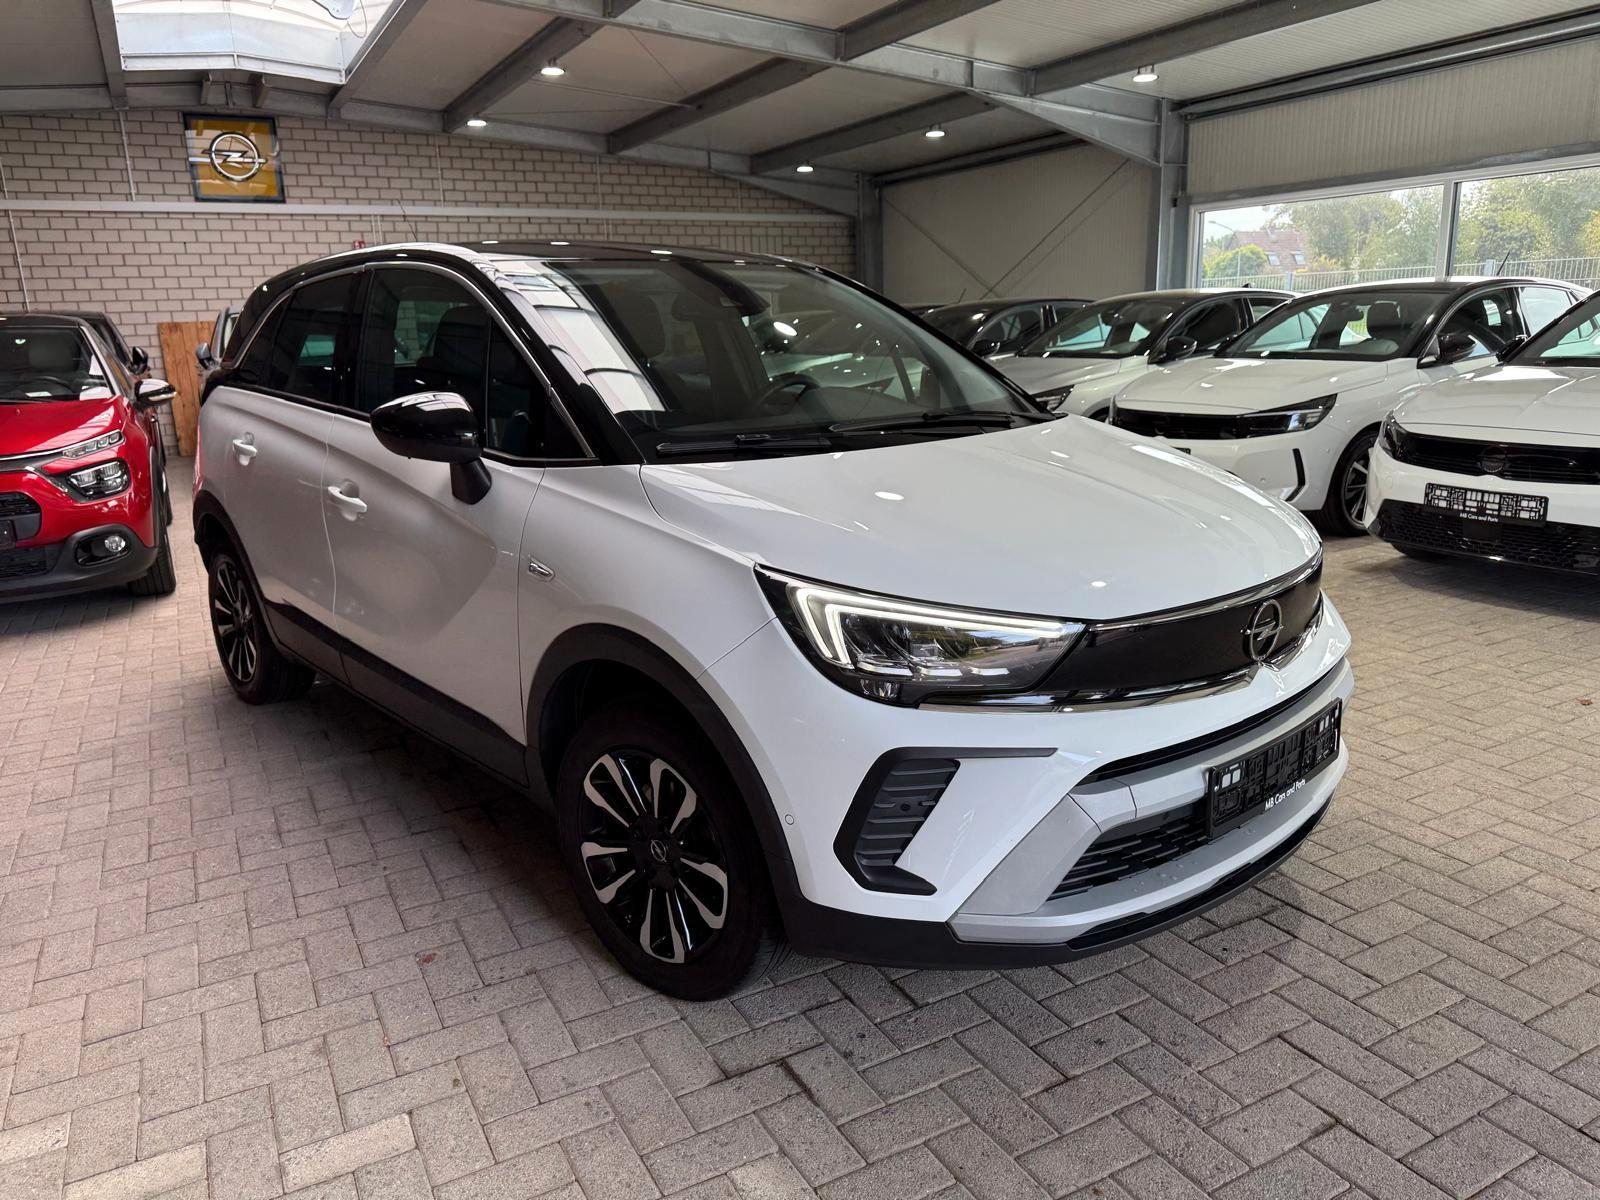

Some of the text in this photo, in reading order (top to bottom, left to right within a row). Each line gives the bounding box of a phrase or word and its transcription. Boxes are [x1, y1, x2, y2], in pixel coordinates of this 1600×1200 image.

[1265, 779, 1305, 810] MB Cars and Parts
